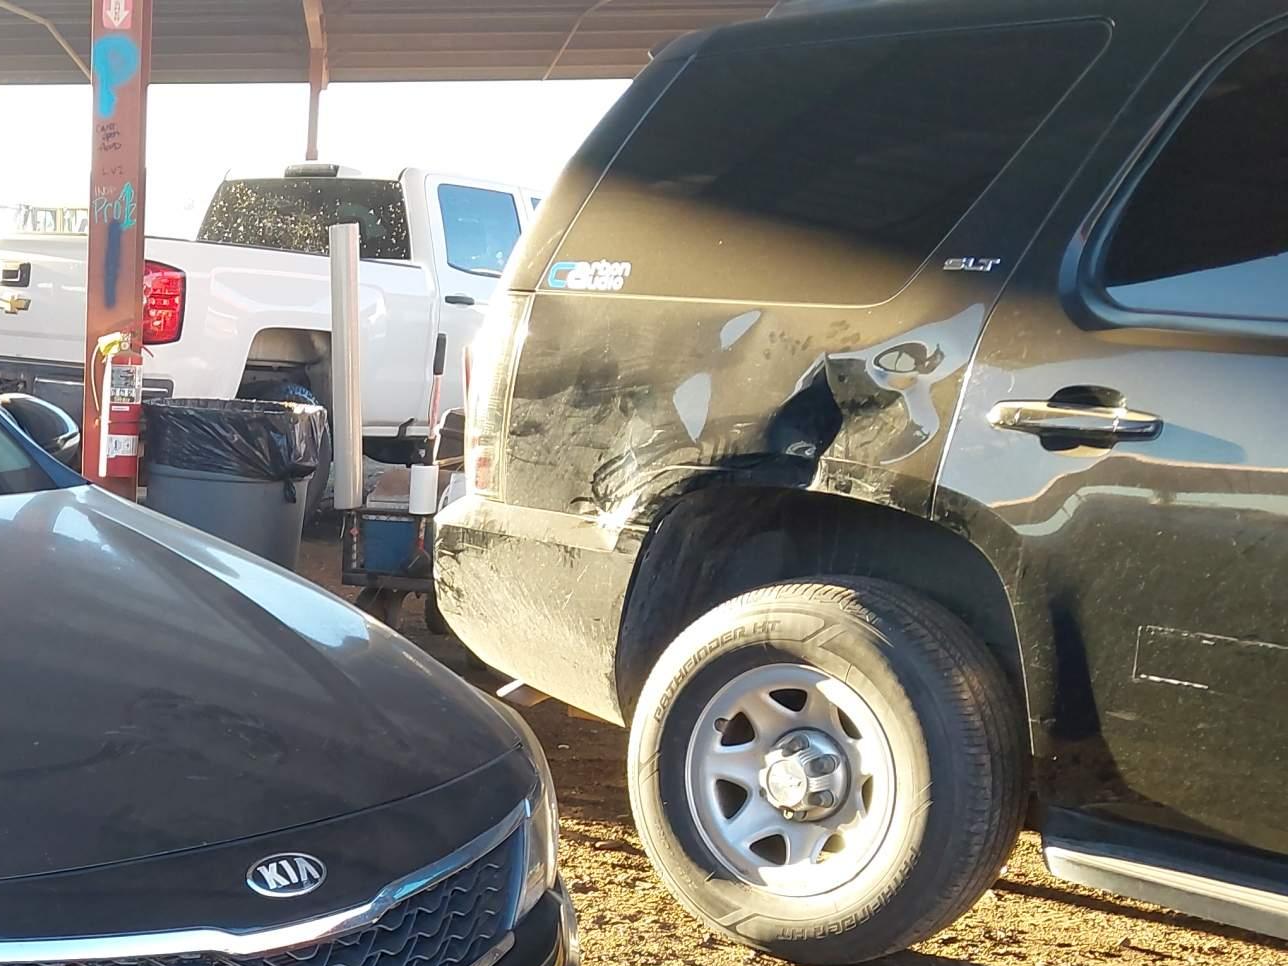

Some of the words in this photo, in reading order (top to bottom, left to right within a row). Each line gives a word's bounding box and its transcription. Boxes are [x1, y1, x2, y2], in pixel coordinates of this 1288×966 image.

[943, 257, 1001, 272] SLT
[653, 625, 746, 724] PATHFINDER
[752, 620, 782, 635] HT
[256, 857, 320, 889] KIA
